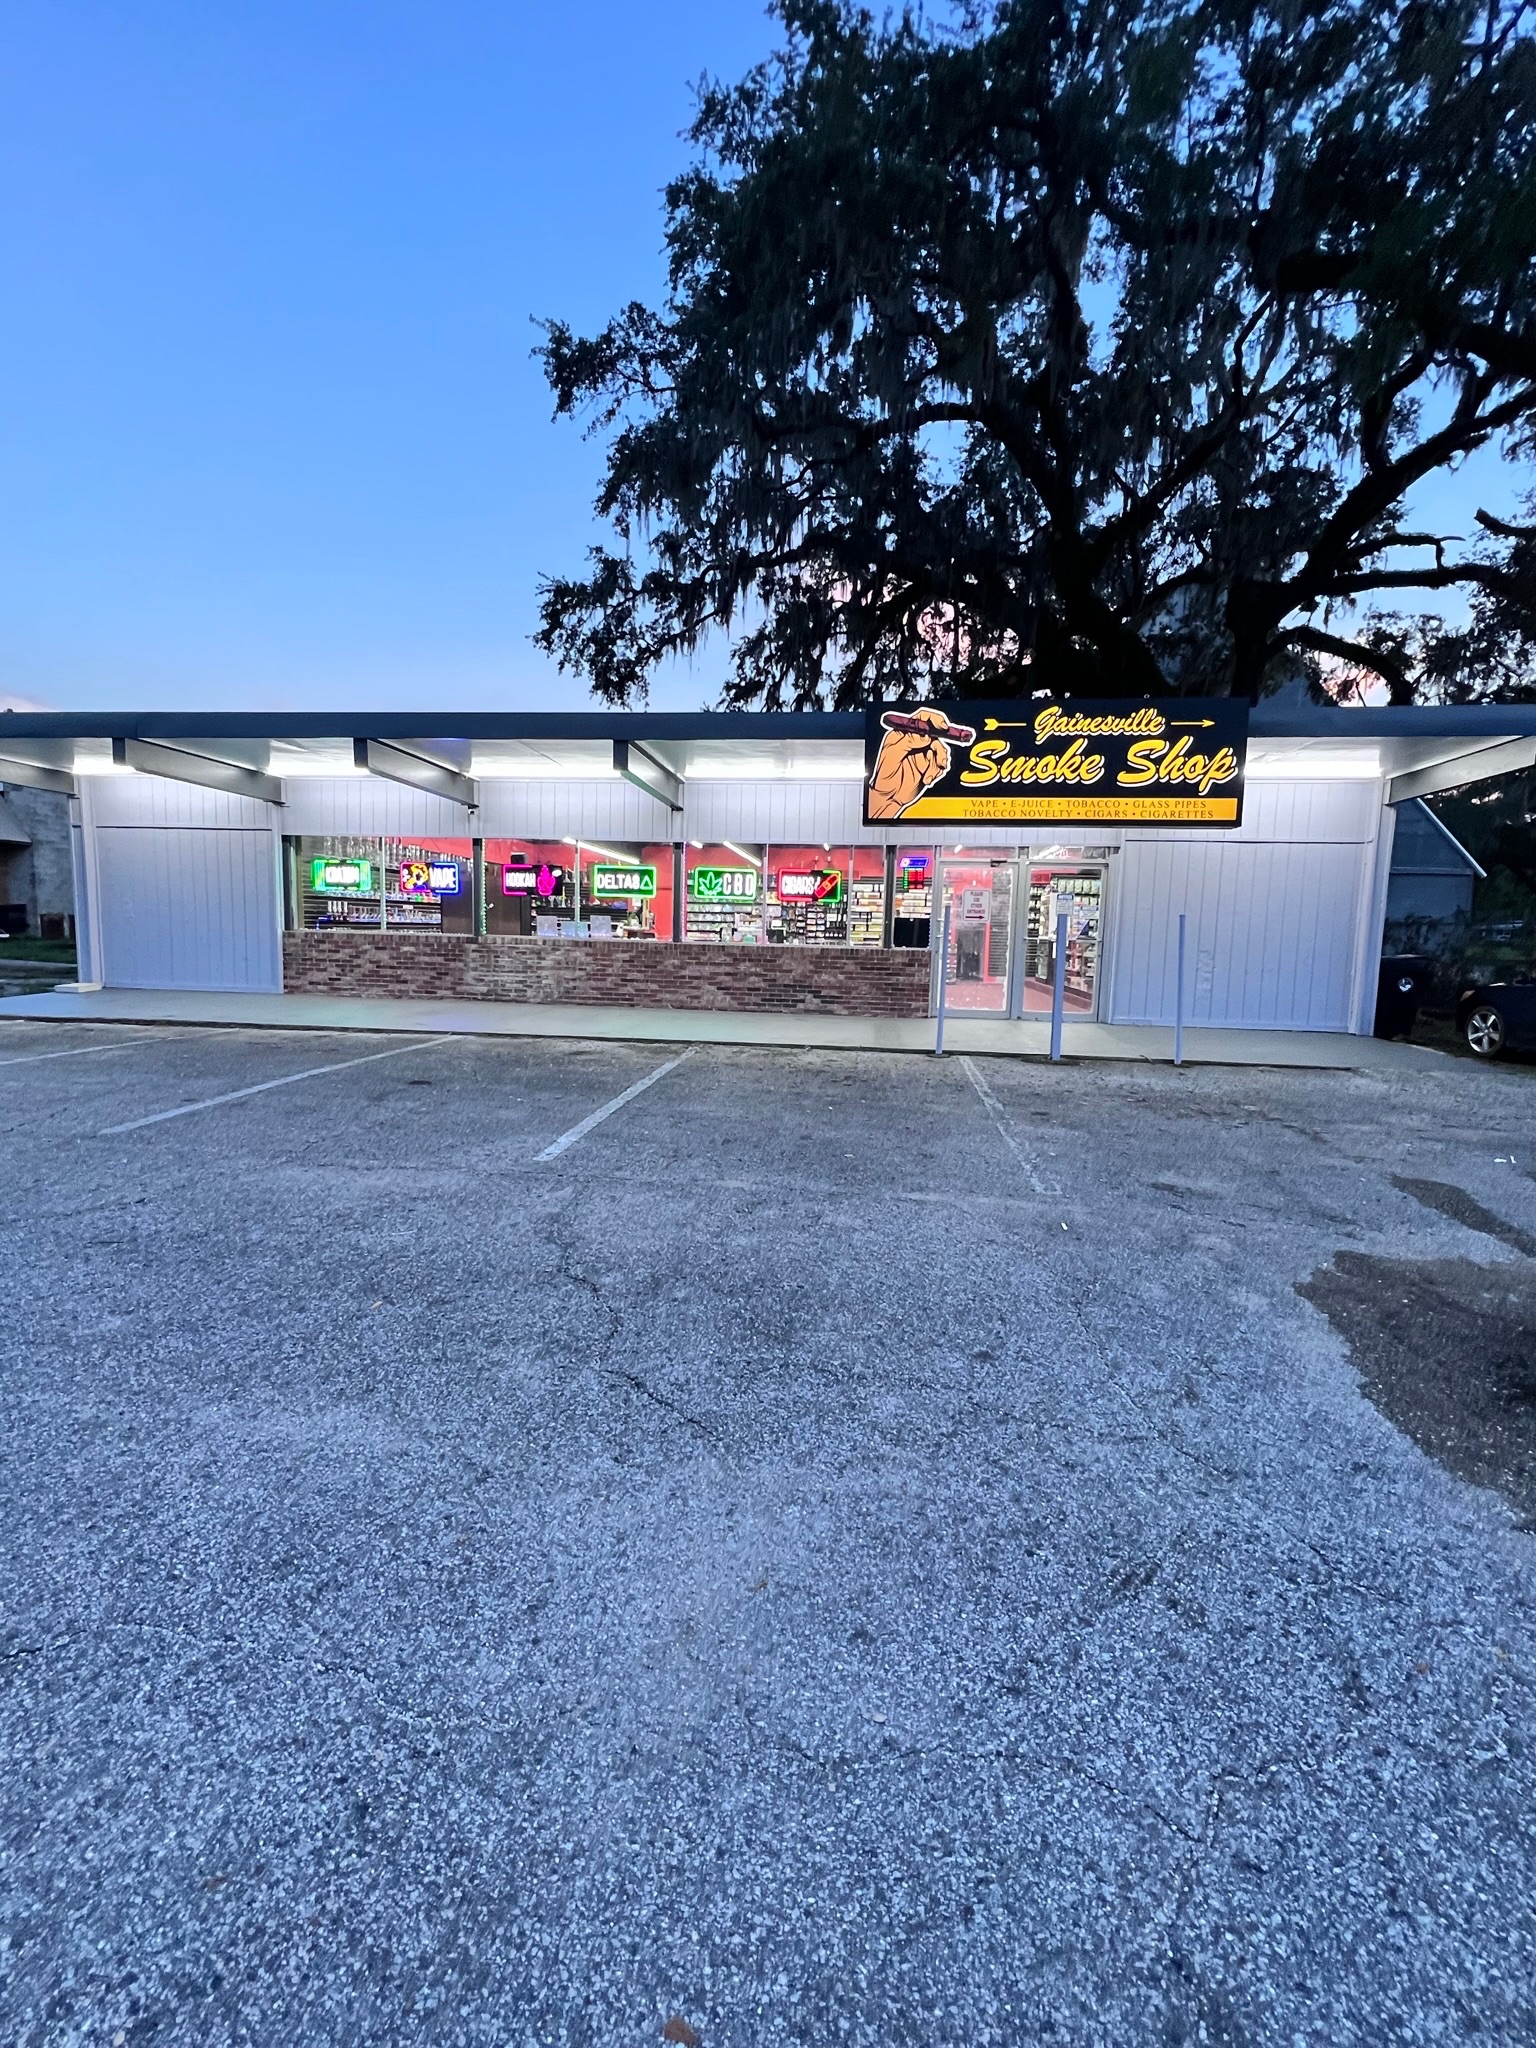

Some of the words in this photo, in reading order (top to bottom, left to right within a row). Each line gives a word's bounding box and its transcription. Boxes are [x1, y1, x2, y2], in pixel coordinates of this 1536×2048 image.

[1034, 706, 1165, 744] Gainesville
[960, 738, 1104, 787] Smoke
[1117, 736, 1238, 795] Shop
[963, 809, 1016, 818] TOBACCO
[1020, 809, 1073, 818] NOVELTY
[1084, 809, 1128, 818] CIGARS
[1140, 810, 1214, 819] CIGARETTES
[970, 799, 998, 808] VAPE
[1010, 799, 1054, 808] E-JUICE
[1066, 799, 1121, 809] TOBACCO
[1132, 800, 1170, 809] GLASS
[1174, 800, 1207, 809] PIPES
[428, 867, 456, 888] VAPE
[505, 872, 536, 888] HOOKAH
[722, 873, 754, 896] CBD
[781, 875, 815, 895] CIGARS
